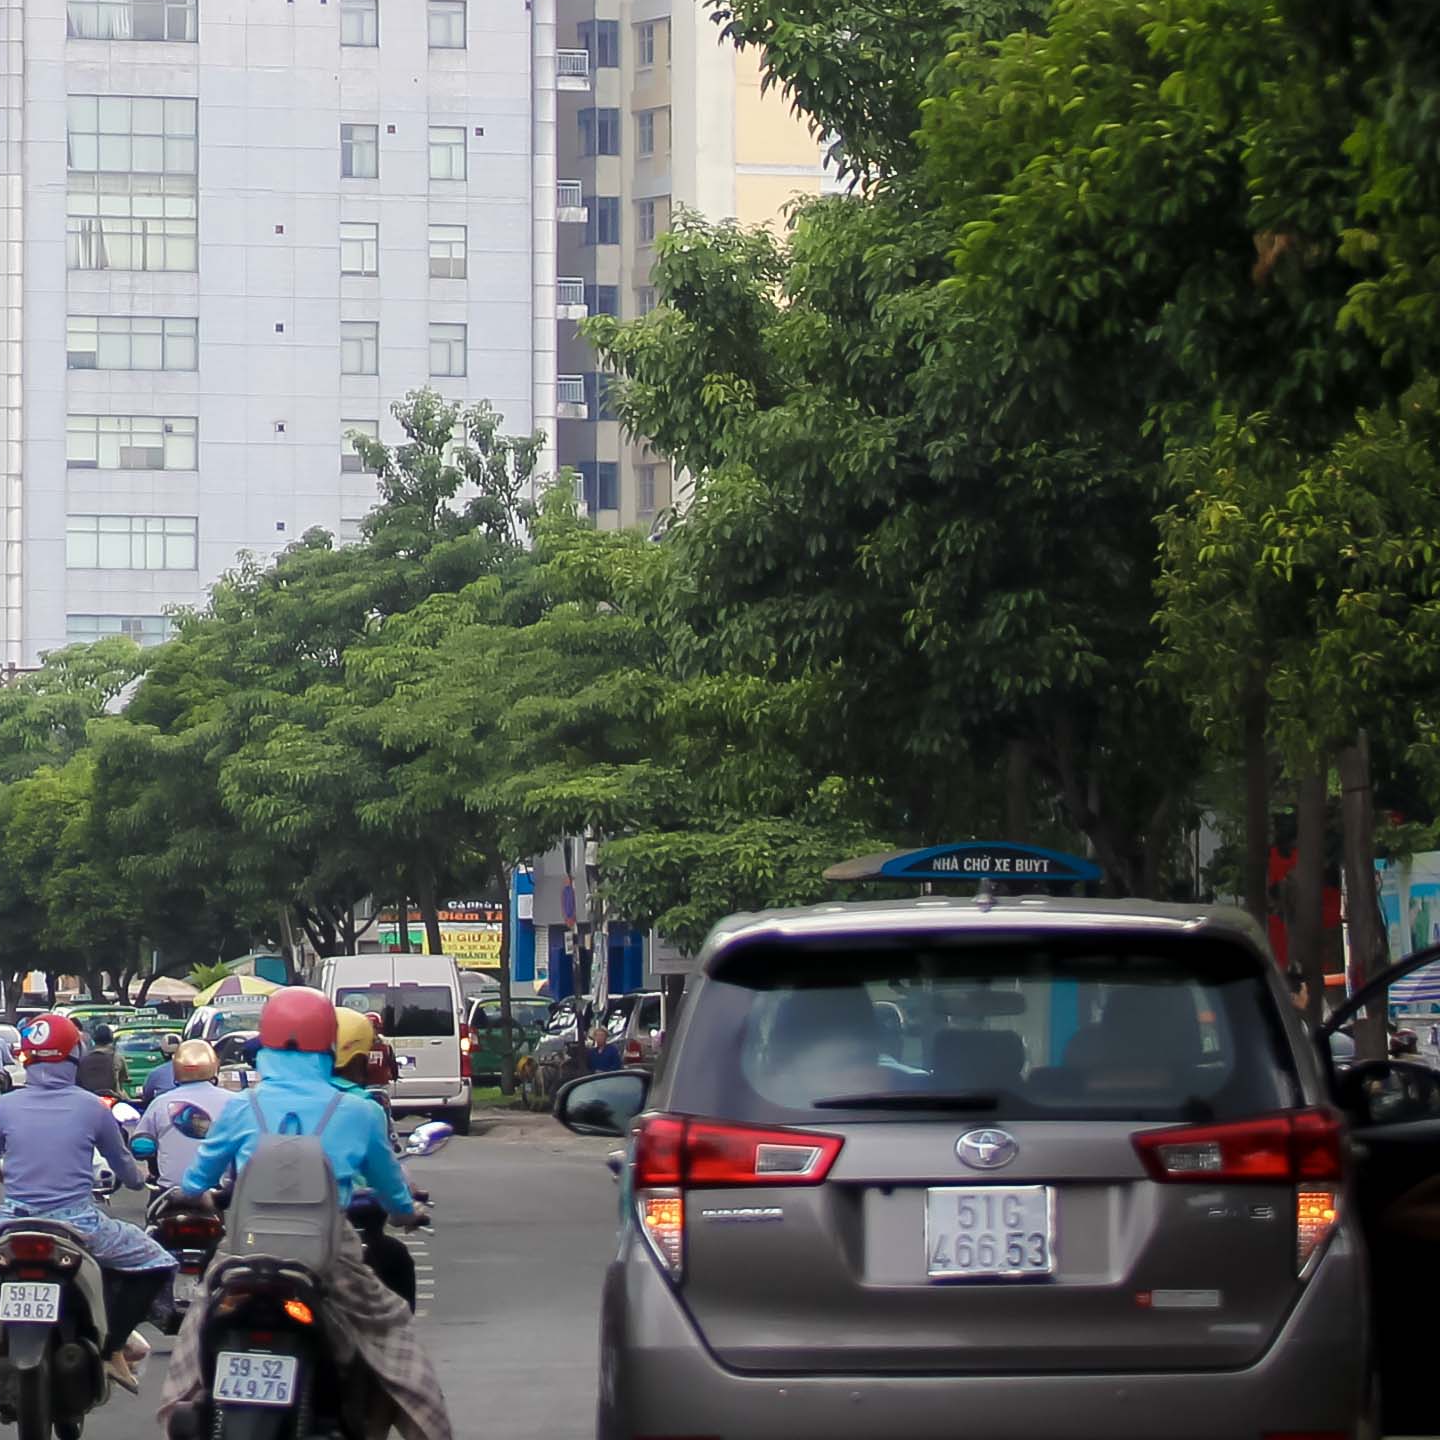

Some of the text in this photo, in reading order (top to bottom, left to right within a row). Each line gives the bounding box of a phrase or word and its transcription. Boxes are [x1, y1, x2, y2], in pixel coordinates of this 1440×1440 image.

[932, 855, 959, 872] NHÀ
[963, 854, 991, 872] CHỜ
[994, 859, 1011, 872] XE
[958, 1194, 1024, 1229] 51G
[931, 1231, 1046, 1268] 466.53
[10, 1286, 50, 1302] 59-L2
[229, 1357, 283, 1380] 59-S2
[219, 1377, 288, 1401] 449.76
